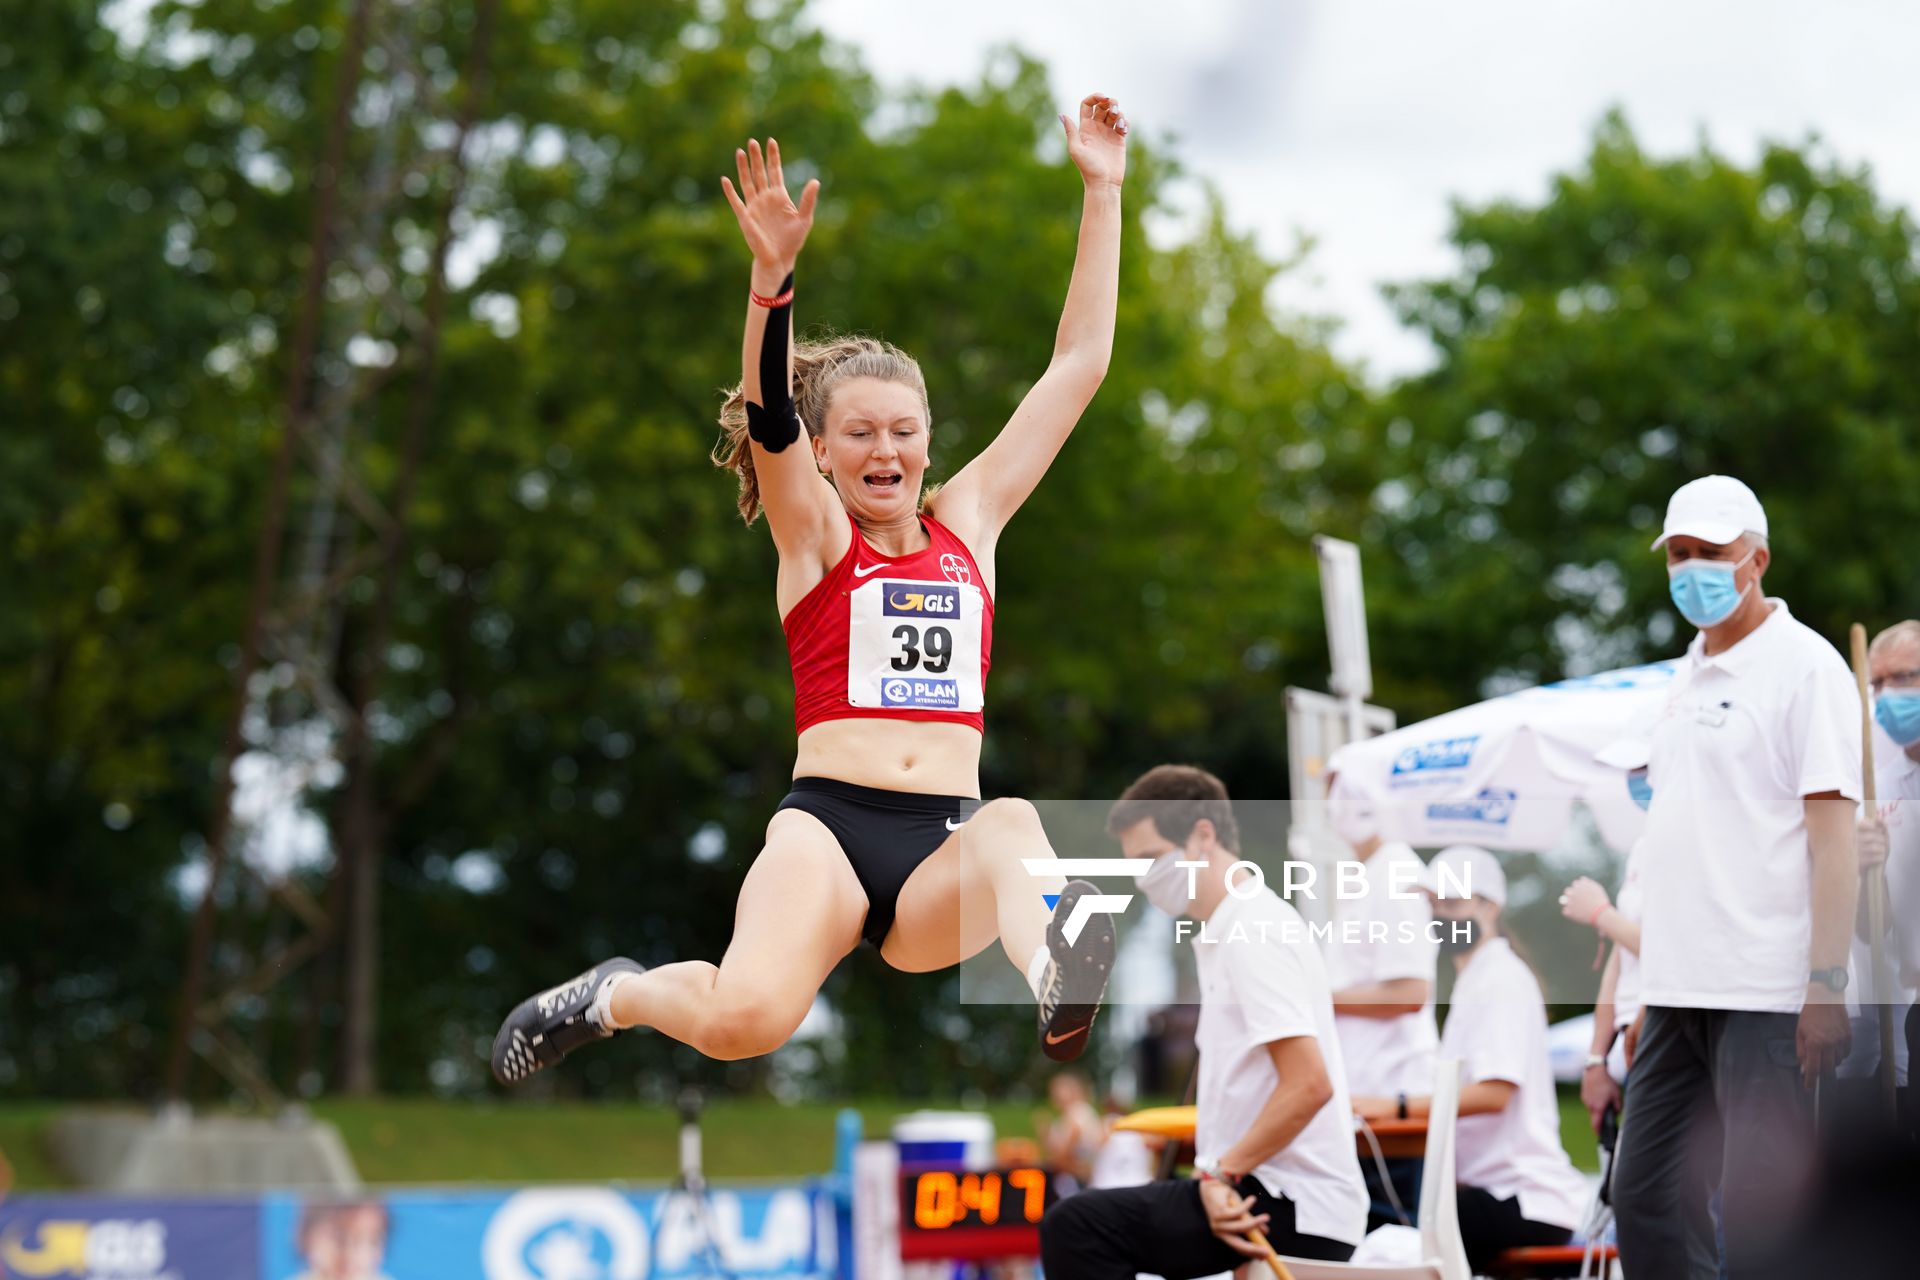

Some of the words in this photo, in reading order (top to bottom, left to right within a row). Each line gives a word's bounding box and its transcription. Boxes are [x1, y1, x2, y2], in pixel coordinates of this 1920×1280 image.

[923, 594, 954, 613] GLS
[891, 624, 952, 673] 39
[914, 682, 956, 698] PLAN
